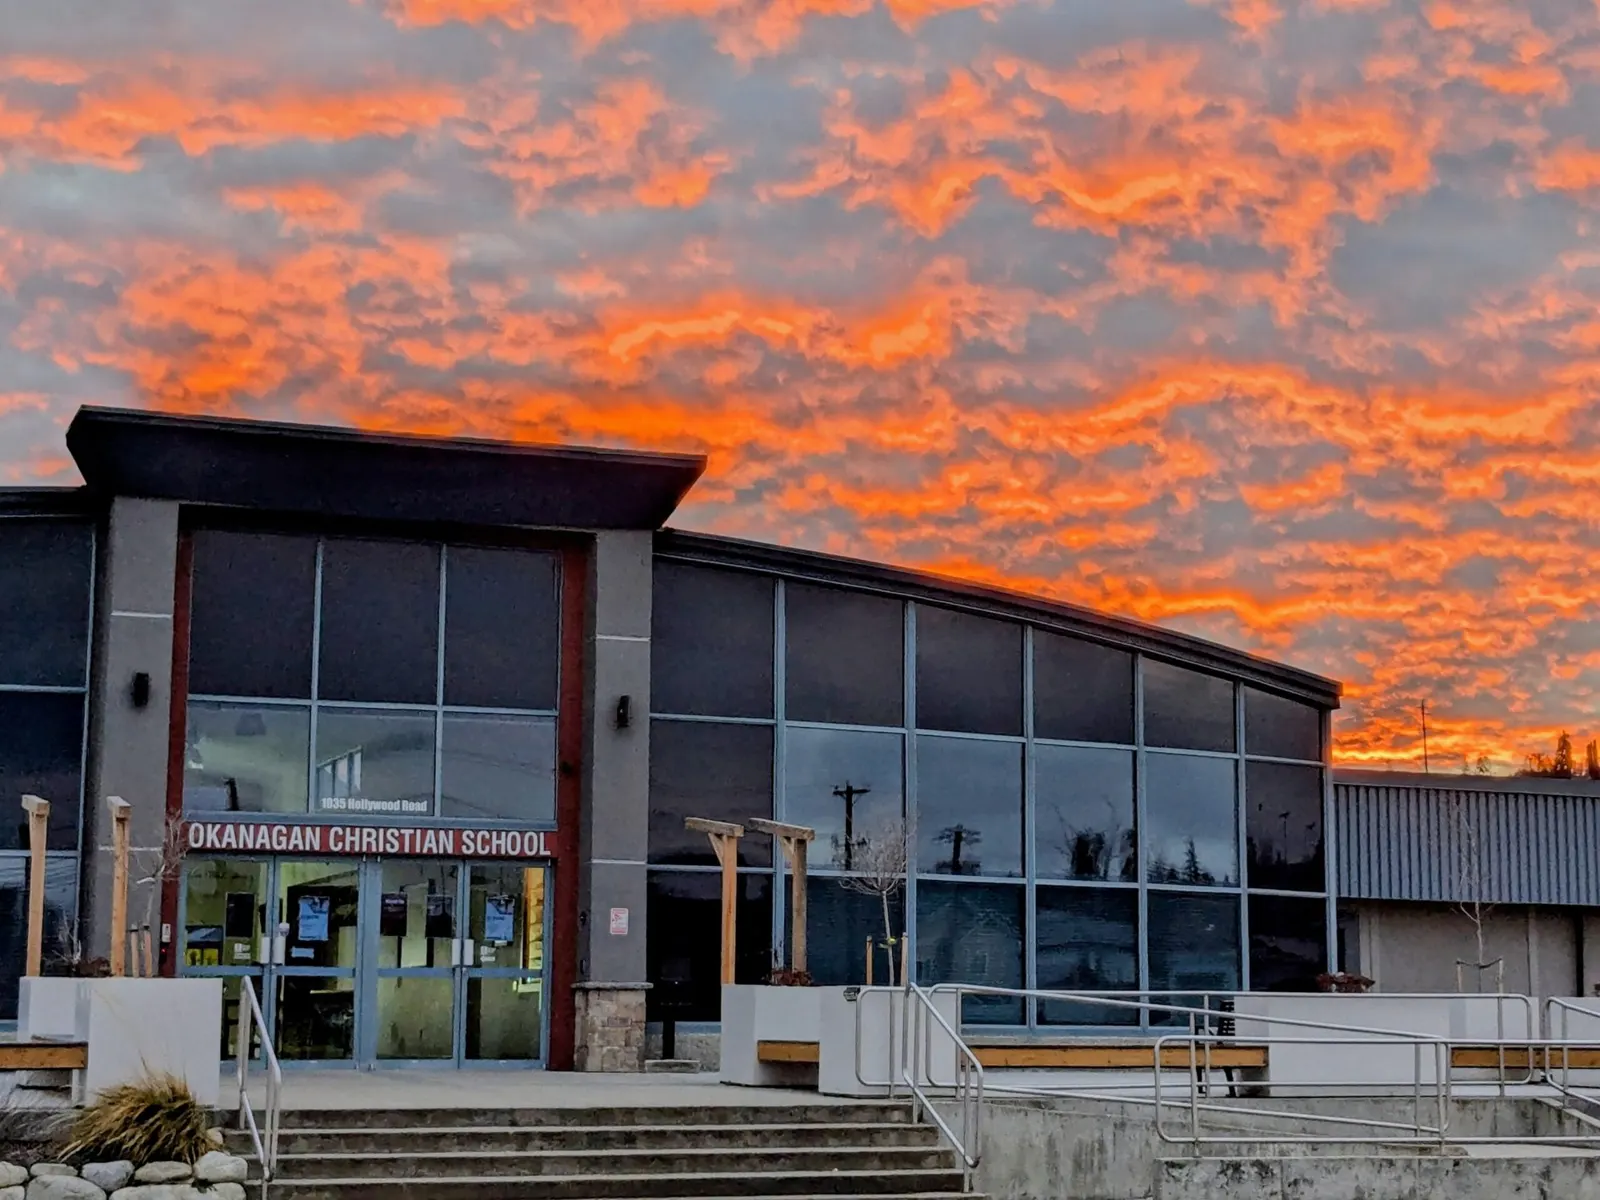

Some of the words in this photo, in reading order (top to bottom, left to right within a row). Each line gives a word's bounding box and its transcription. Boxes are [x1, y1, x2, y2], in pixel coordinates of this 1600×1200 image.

[348, 798, 400, 811] Hollywood
[402, 800, 427, 812] Road
[189, 822, 320, 851] OKANAGAN
[329, 826, 453, 854] CHRISTIAN
[461, 830, 551, 856] SCHOOL
